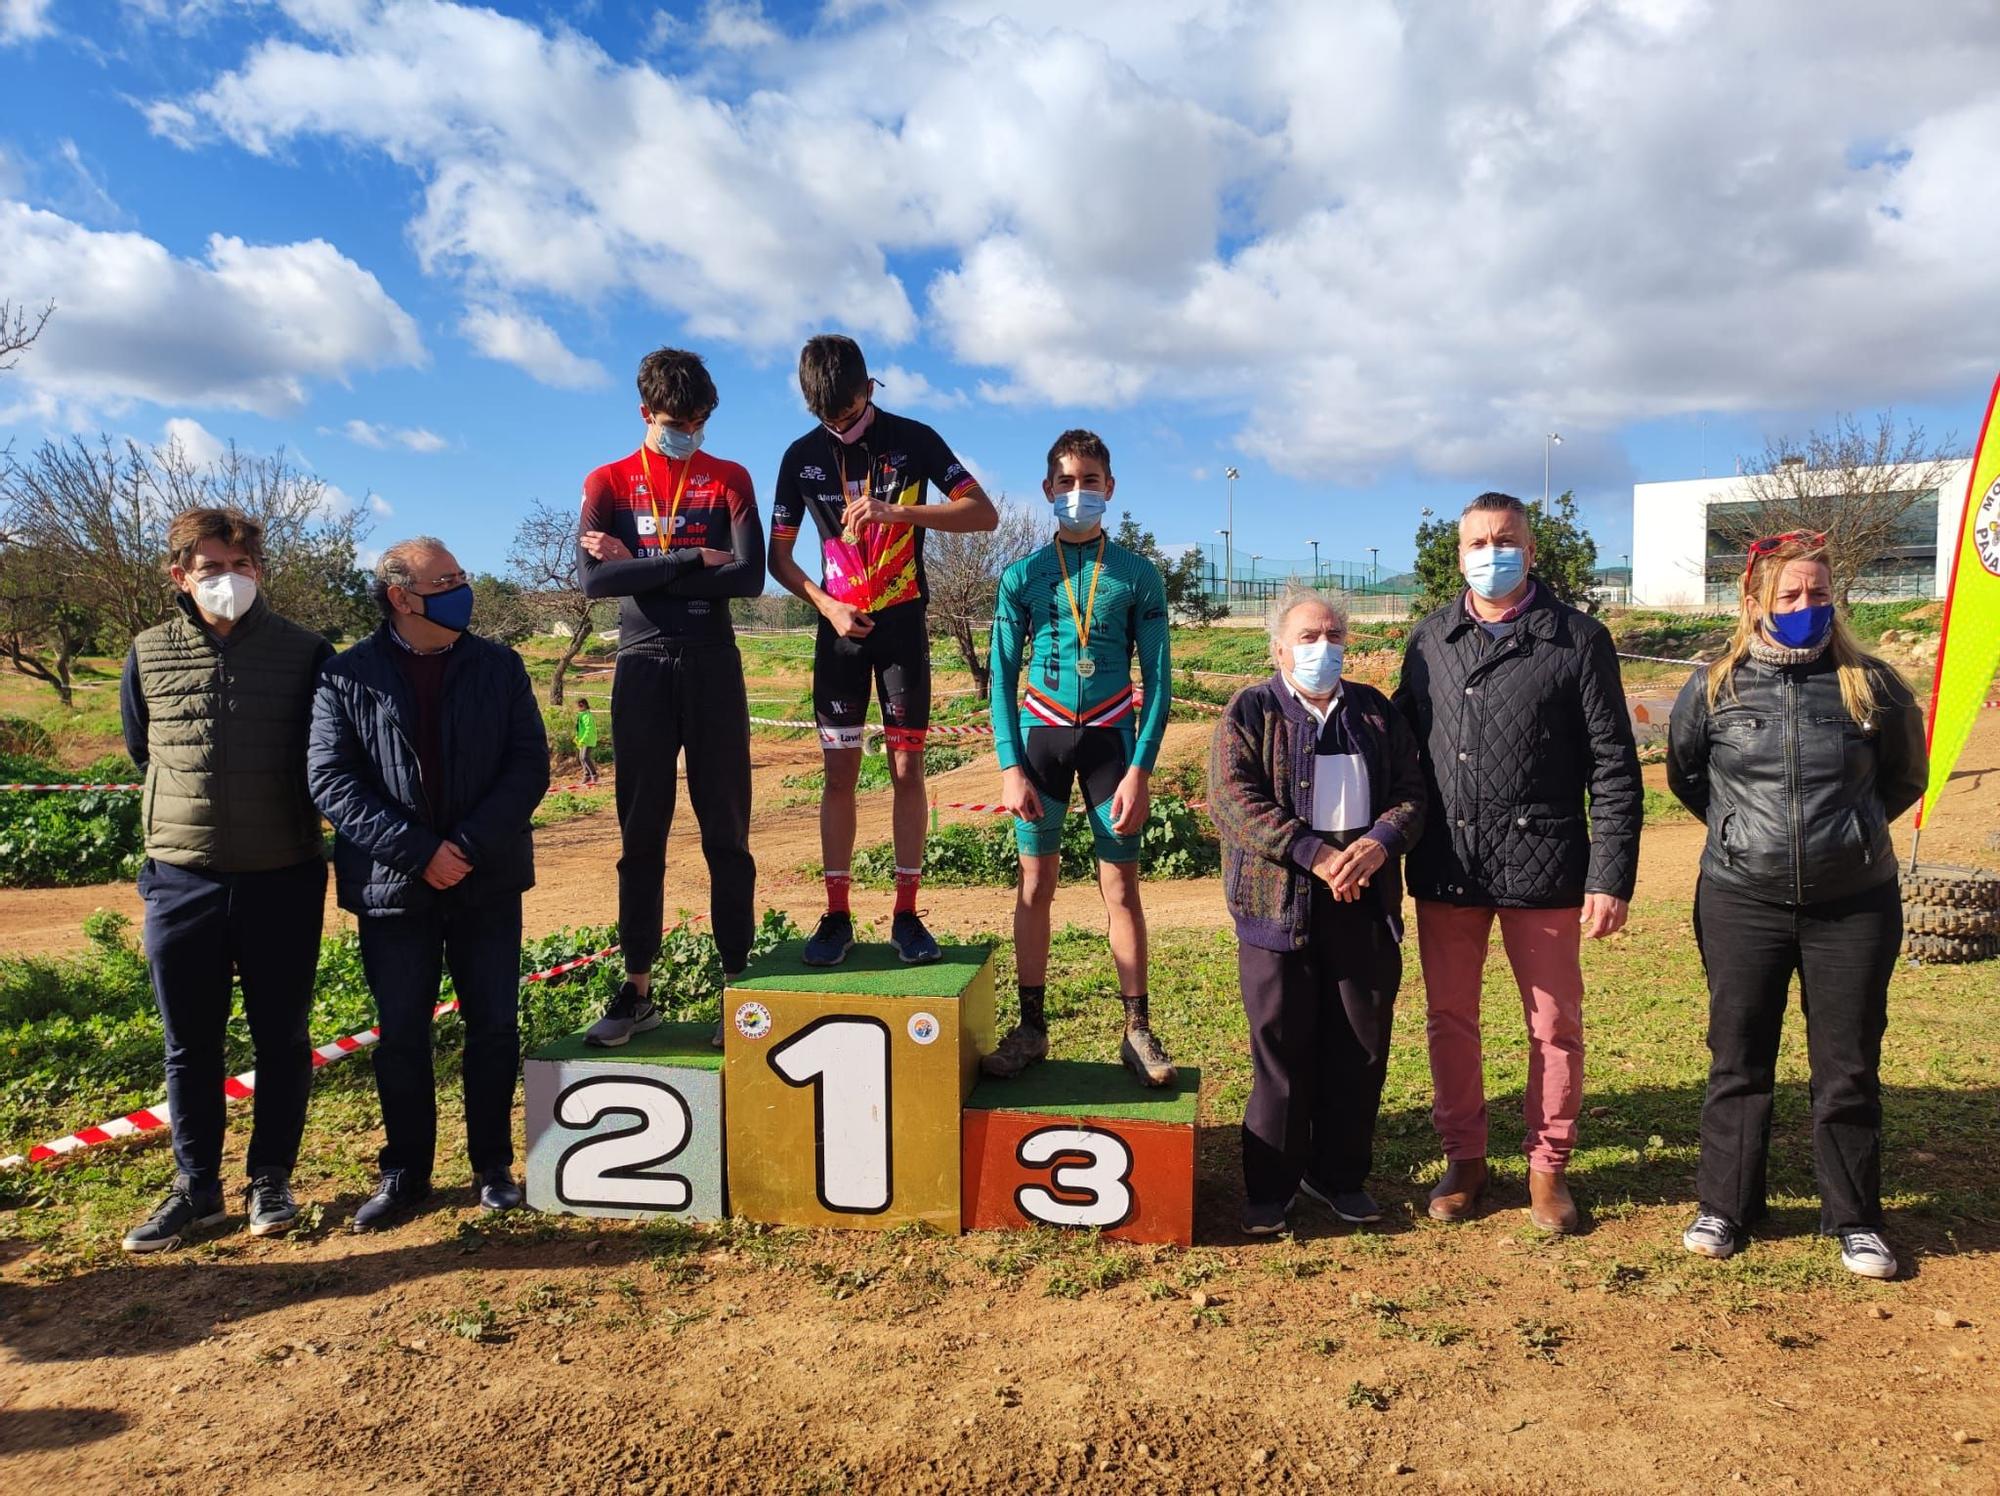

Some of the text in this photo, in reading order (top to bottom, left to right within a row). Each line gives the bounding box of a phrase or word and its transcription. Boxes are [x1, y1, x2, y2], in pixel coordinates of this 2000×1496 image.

[553, 1075, 692, 1211] 2
[767, 1014, 893, 1214] 1
[1014, 1126, 1133, 1229] 3
